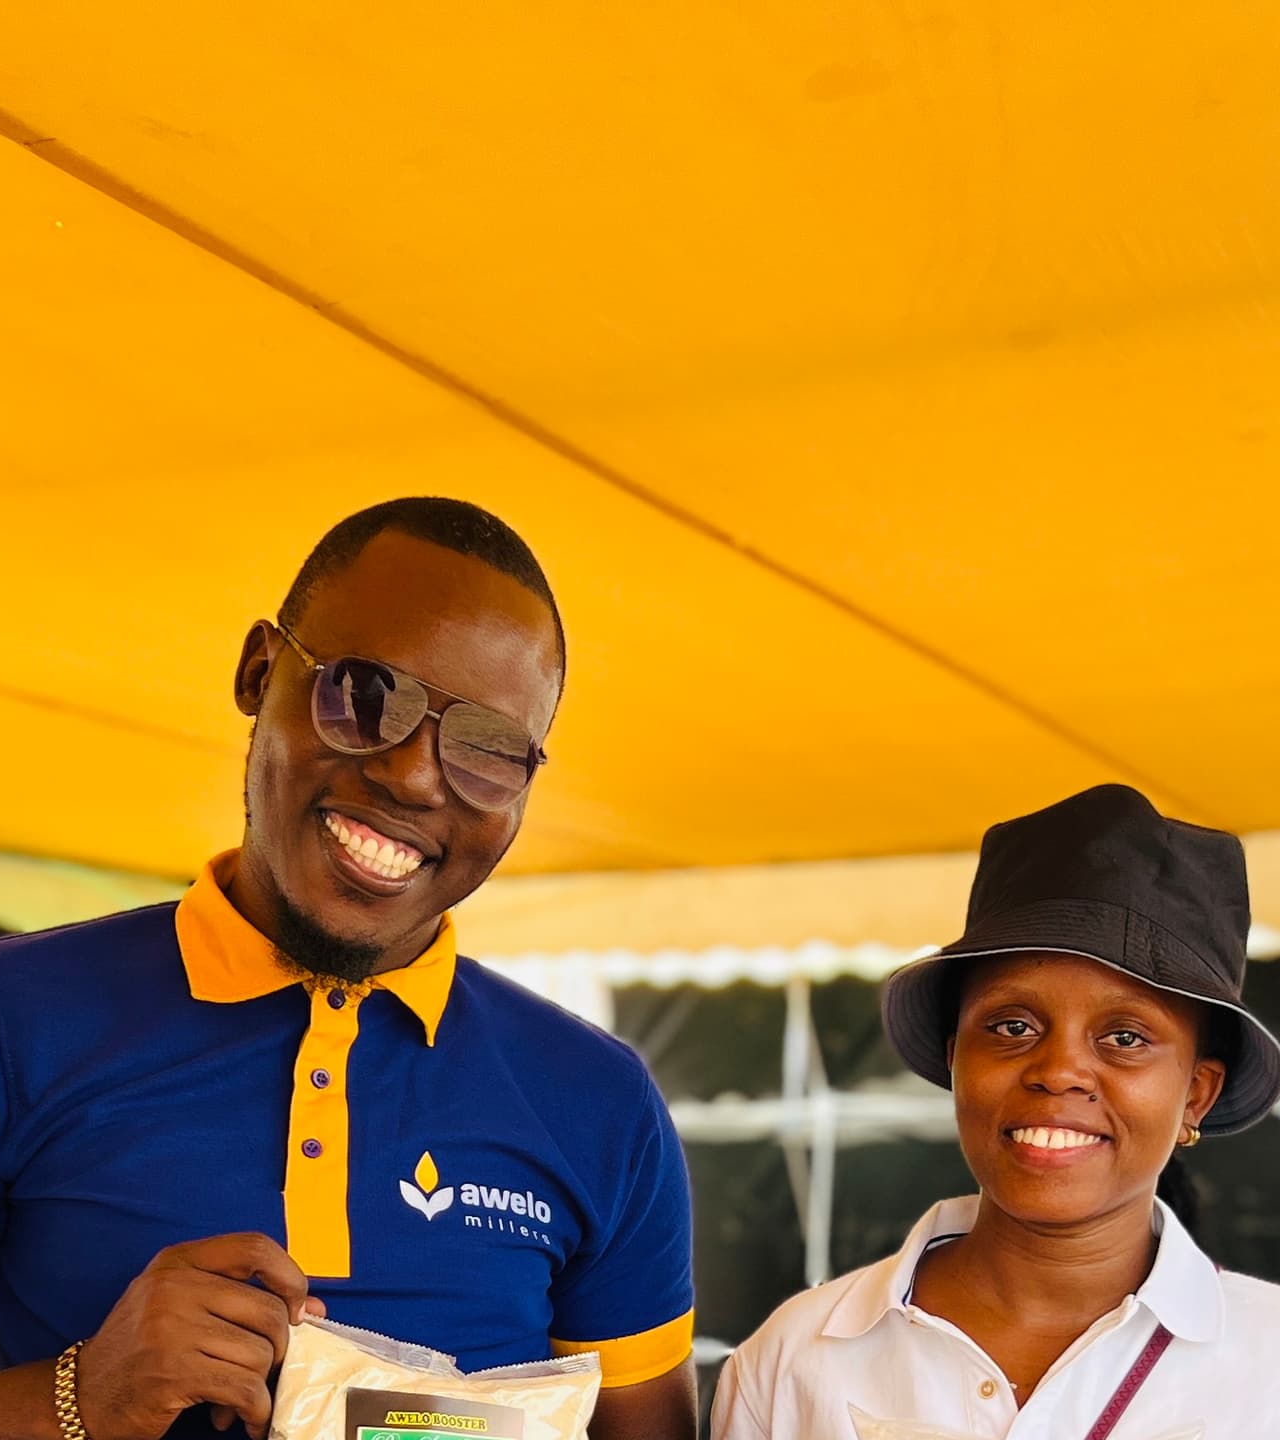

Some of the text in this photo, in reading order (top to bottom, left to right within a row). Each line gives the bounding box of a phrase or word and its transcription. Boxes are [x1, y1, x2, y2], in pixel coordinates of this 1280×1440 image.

[460, 1182, 551, 1224] awelo
[464, 1215, 551, 1245] millers
[386, 1411, 488, 1431] AWELO BOOSTER
